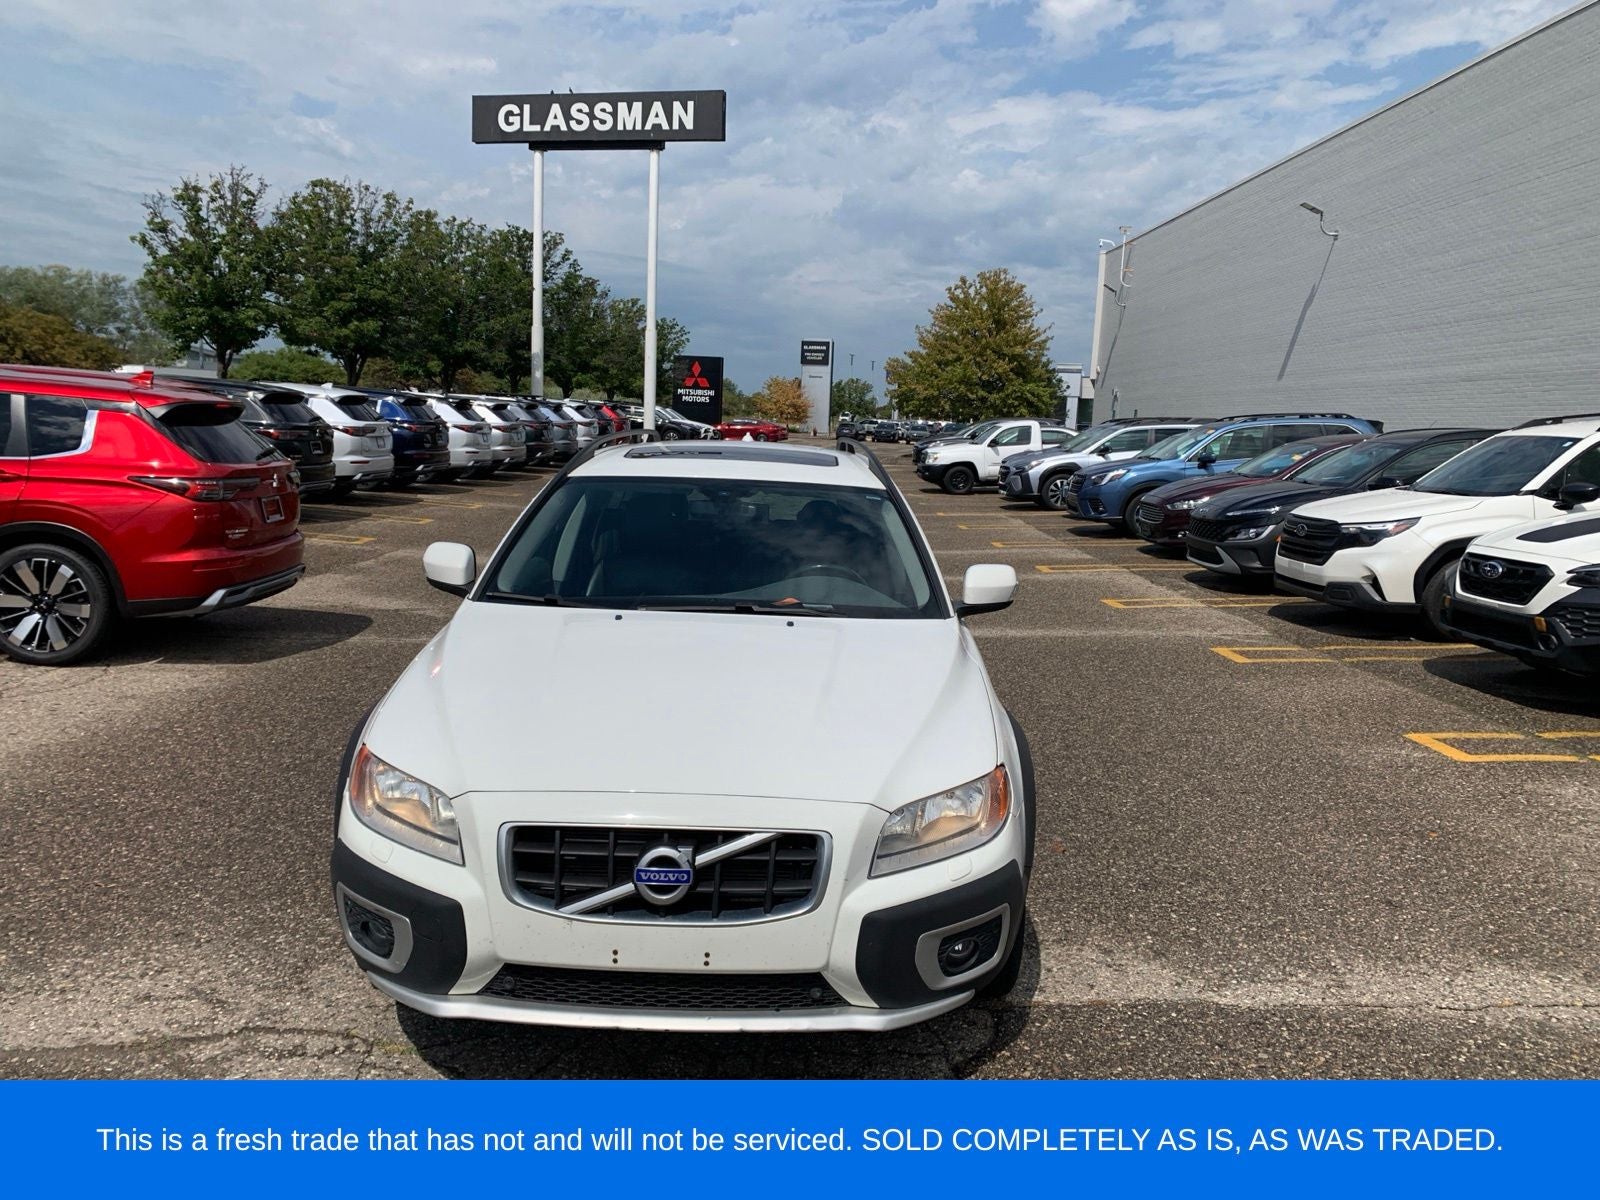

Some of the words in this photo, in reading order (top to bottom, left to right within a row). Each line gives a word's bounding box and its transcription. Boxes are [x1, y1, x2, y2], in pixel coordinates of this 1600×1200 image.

[497, 100, 695, 133] GLASSMAN
[677, 388, 715, 396] MITSUBISHI
[682, 395, 710, 403] MOTORS
[639, 871, 688, 881] VOLVO
